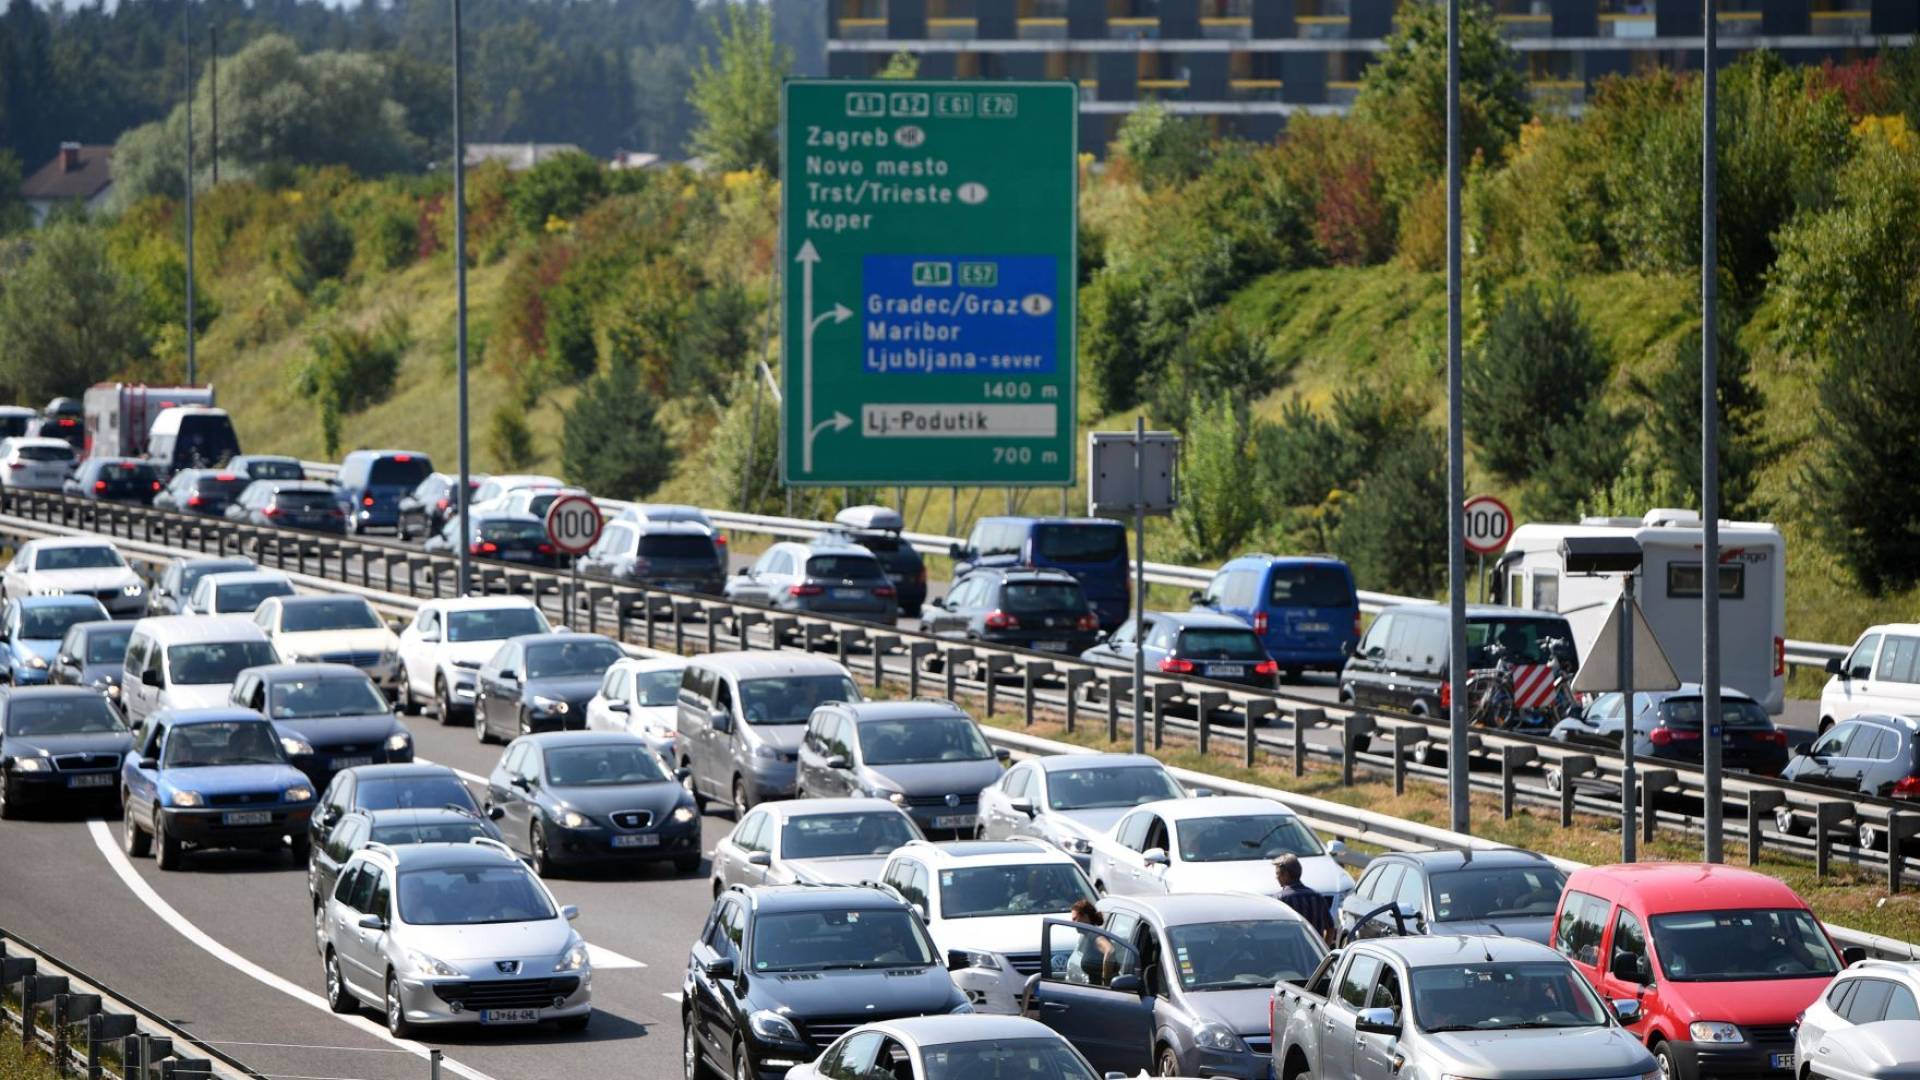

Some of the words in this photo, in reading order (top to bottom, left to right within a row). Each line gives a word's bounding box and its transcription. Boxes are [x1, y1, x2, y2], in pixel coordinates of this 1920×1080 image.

[856, 97, 874, 112] A1
[900, 97, 920, 112] A2
[806, 126, 888, 150] Zagreb
[806, 156, 864, 175] Novo
[877, 158, 948, 175] mesto
[808, 181, 952, 204] Trst/Trieste
[806, 210, 872, 232] Koper
[922, 266, 940, 280] A1
[868, 292, 1018, 316] Gradec/Graz
[868, 322, 960, 340] Maribor
[984, 382, 1032, 398] 1400
[1042, 386, 1058, 398] m
[868, 411, 988, 433] Lj.-Podutik
[994, 448, 1031, 464] 700
[1042, 451, 1058, 463] m
[557, 511, 594, 538] 100
[1466, 511, 1505, 538] 100
